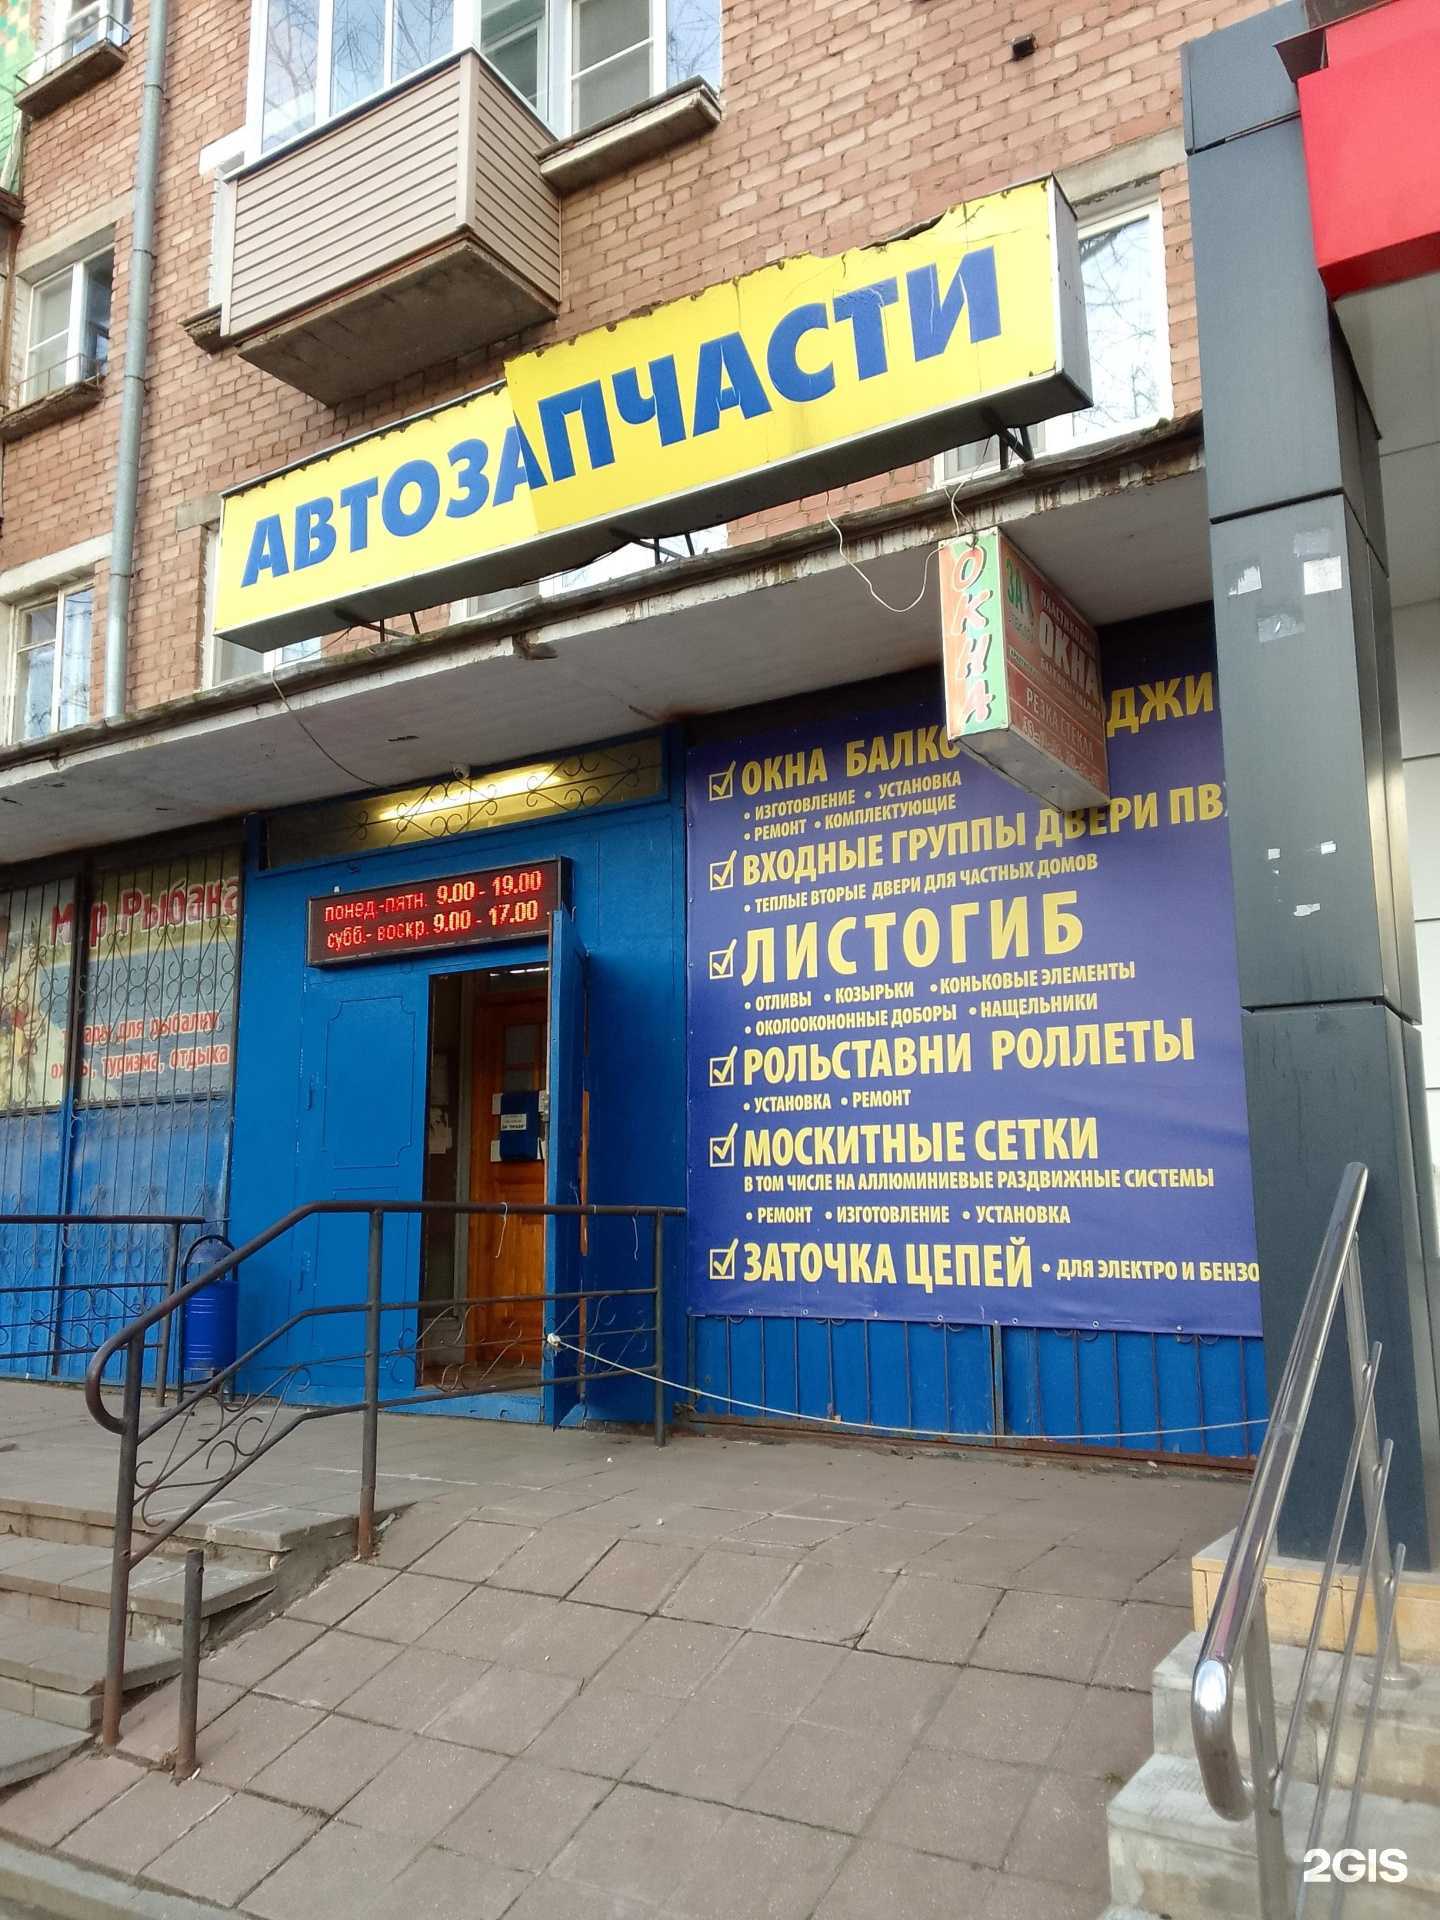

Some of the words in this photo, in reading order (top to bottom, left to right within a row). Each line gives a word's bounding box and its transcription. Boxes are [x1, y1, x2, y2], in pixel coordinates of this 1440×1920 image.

[240, 246, 1002, 589] АВТОЗАПЧАСТИ
[952, 546, 995, 724] ОКНА
[1039, 609, 1100, 704] ОКНА
[741, 748, 828, 796] ОКНА
[755, 789, 855, 820] ИЗГОТОВЛЕНИЕ
[879, 770, 961, 799] УСТАНОВКА
[743, 833, 884, 887] ВХОДНЫЕ
[892, 811, 1026, 865] ГРУППЫ
[1036, 792, 1158, 847] ДВЕРИ
[754, 819, 806, 841] РЕМОНТ
[825, 793, 956, 829] КОМПЛЕКТУЮЩИЕ
[437, 881, 475, 904] 9.00
[492, 869, 542, 896] 19.00
[755, 890, 807, 912] ТЕПЛЫЕ
[811, 884, 866, 906] ВТОРЫЕ
[872, 880, 921, 899] ДВЕРИ
[924, 873, 956, 893] ДЛЯ
[960, 862, 1034, 887] ЧАСТНЫХ
[1037, 853, 1098, 878] ДОМОВ
[51, 903, 108, 947] Мр
[433, 909, 471, 933] 9.00
[489, 900, 538, 926] 17.00
[742, 891, 1083, 986] ЛИСТОГИБ
[755, 990, 812, 1011] ОТЛИВЫ
[836, 981, 914, 1004] КОЗЫРЬКИ
[940, 969, 1038, 994] КОНЬКОВЫЕ
[1041, 961, 1136, 985] ЭЛЕМЕНТЫ
[891, 1005, 957, 1028] ДОБОРЫ
[981, 993, 1098, 1018] НАЩЕЛЬНИКИ
[743, 1031, 972, 1085] РОЛЬСТАВНИ
[993, 1017, 1195, 1071] РОЛЛЕТЫ
[755, 1094, 831, 1113] УСТАНОВКА
[853, 1089, 911, 1108] РЕМОНТ
[744, 1121, 965, 1167] МОСКИТНЫЕ
[975, 1117, 1098, 1161] СЕТКИ
[744, 1176, 753, 1192] В
[756, 1175, 784, 1192] ТОМ
[786, 1174, 832, 1191] ЧИСЛЕ
[836, 1173, 855, 1190] НА
[858, 1171, 993, 1190] АЛЛЮМИНИЕВЫЕ
[997, 1169, 1120, 1191] РАЗДВИЖНЫЕ
[1124, 1168, 1214, 1188] СИСТЕМЫ
[757, 1206, 812, 1223] РЕМОНТ
[836, 1206, 949, 1223] ИЗГОТОВЛЕНИЕ
[976, 1205, 1070, 1224] УСТАНОВКА
[743, 1243, 896, 1284] ЗАТОЧКА
[906, 1236, 1033, 1293] ЦЕПЕЙ
[1057, 1259, 1094, 1279] ДЛЯ
[1098, 1260, 1177, 1280] ЭЛЕКТРО
[1182, 1262, 1195, 1280] И
[1199, 1262, 1260, 1282] БЕНЗО
